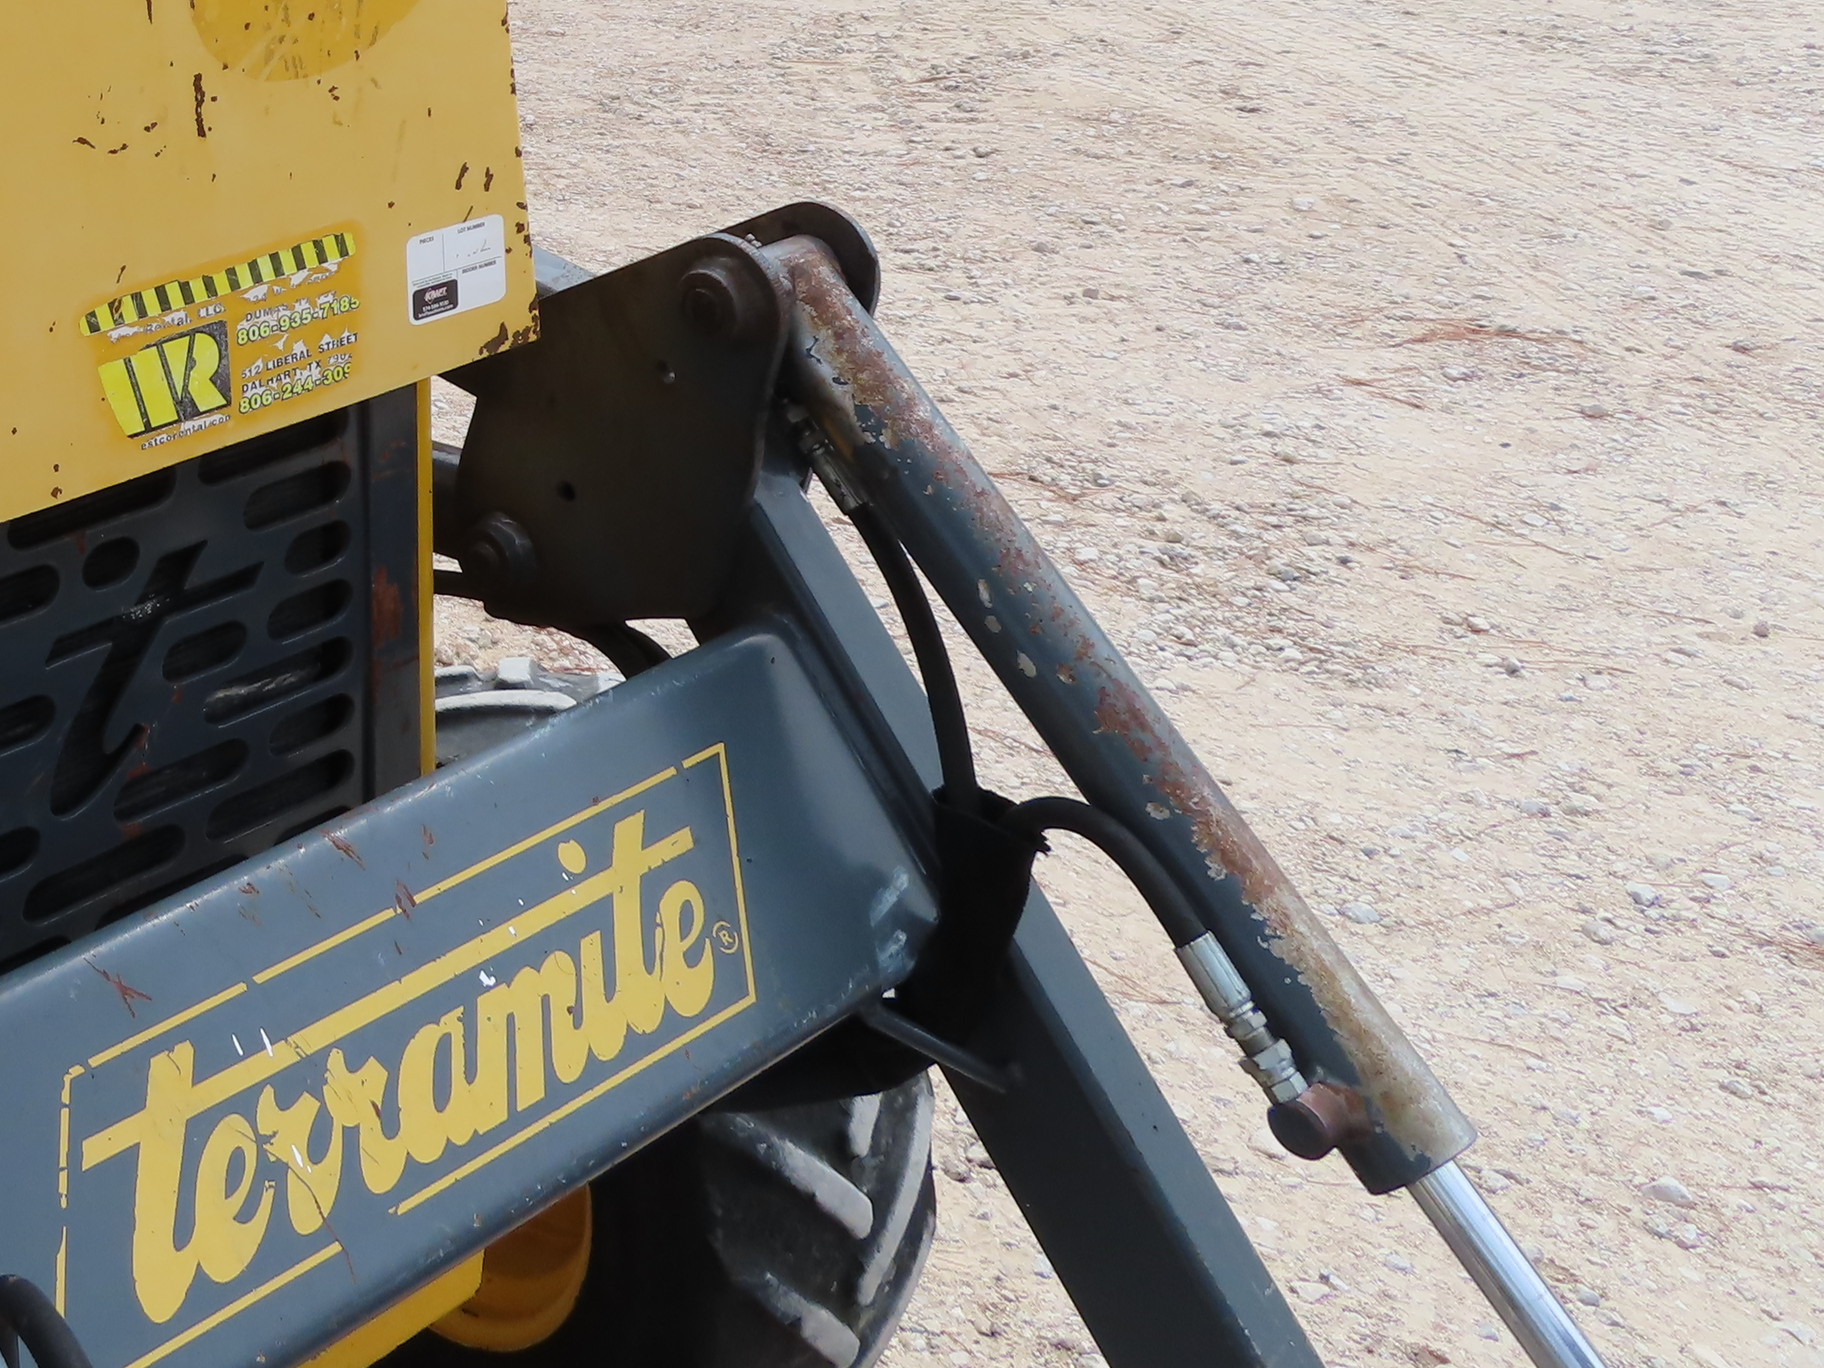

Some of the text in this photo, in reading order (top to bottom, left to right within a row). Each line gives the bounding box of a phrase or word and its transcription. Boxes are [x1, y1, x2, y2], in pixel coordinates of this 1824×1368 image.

[236, 296, 360, 346] 806-935-7185
[265, 348, 312, 371] LIBERAL
[318, 333, 358, 353] STREET
[308, 360, 322, 372] TX
[81, 810, 715, 1325] terramite
